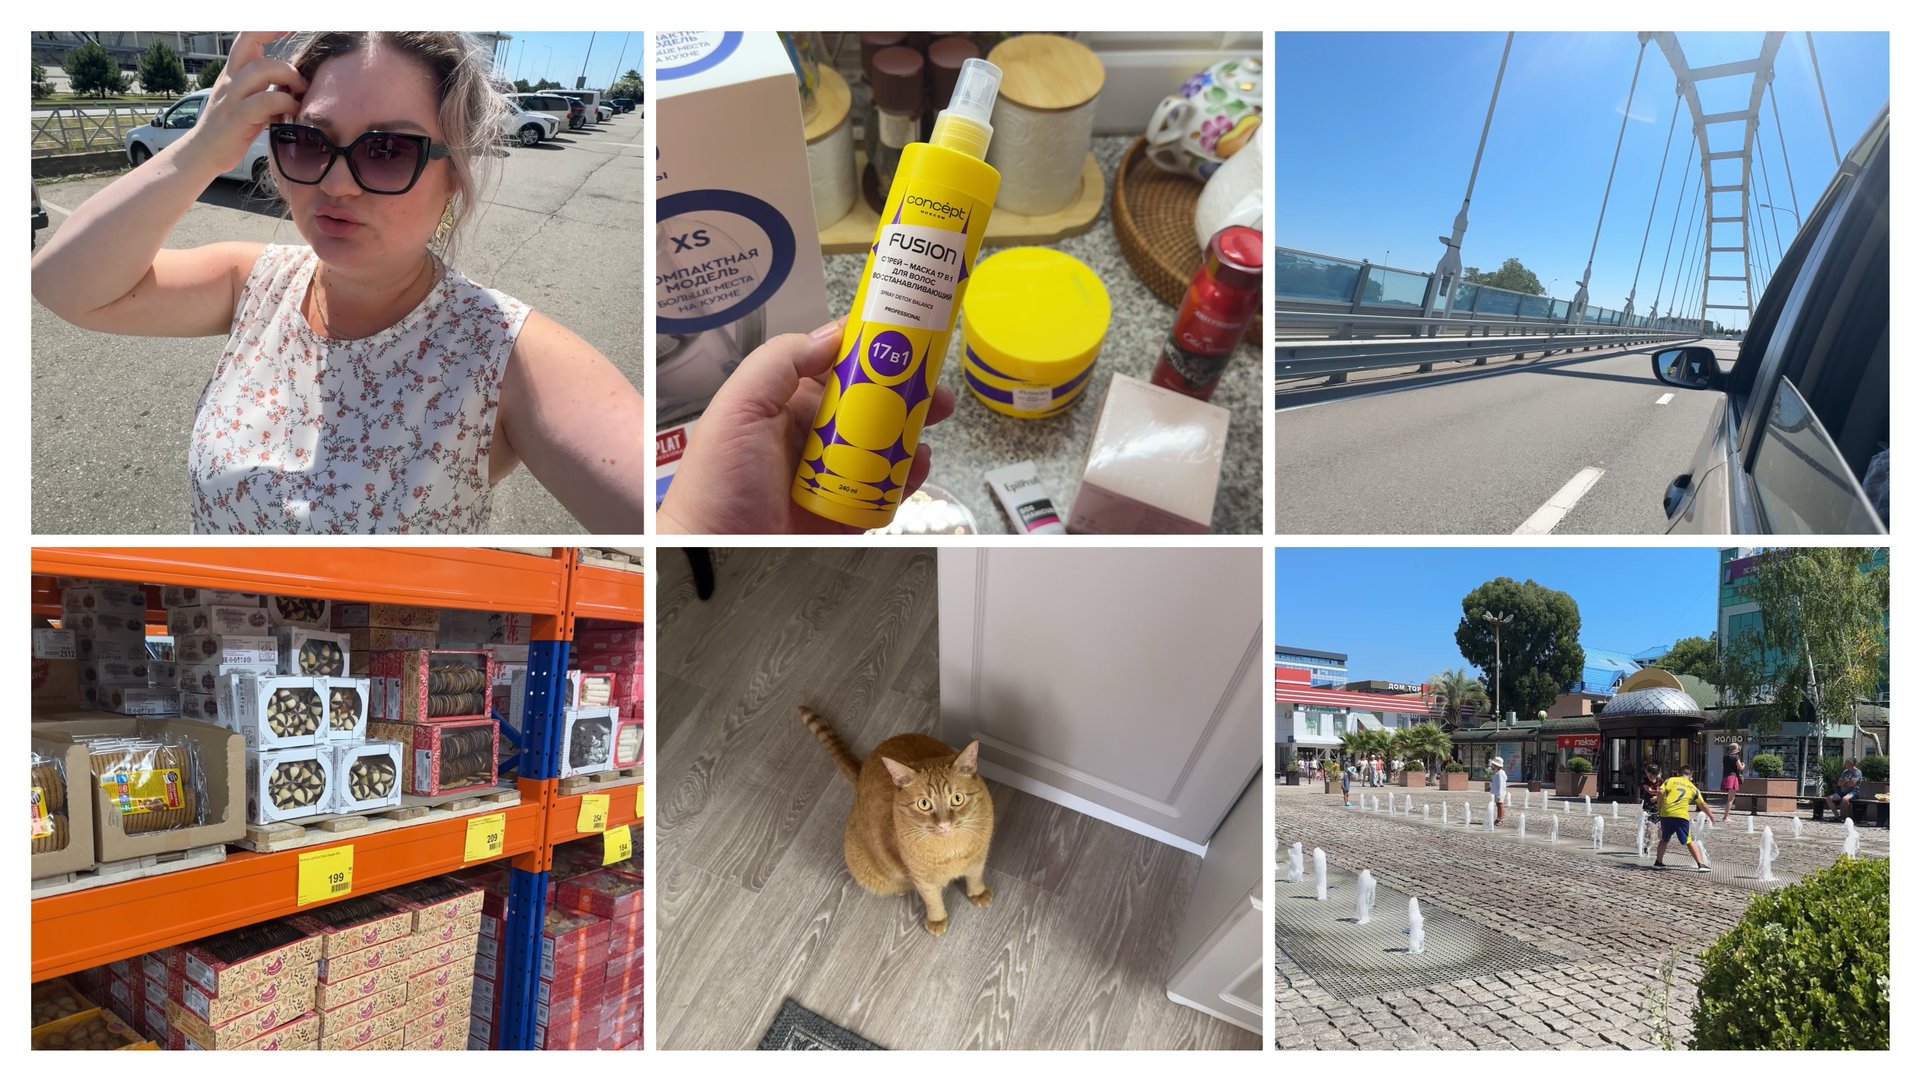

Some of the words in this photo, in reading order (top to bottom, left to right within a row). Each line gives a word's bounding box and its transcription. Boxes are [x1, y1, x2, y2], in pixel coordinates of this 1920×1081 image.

[892, 268, 909, 277] ДЛЯ
[909, 272, 936, 286] ВОЛОС
[909, 263, 936, 277] МАСКА
[666, 267, 739, 293] МОДЕЛЬ
[658, 287, 713, 309] БОЛЬШЕ
[714, 275, 754, 292] МЕСТА
[880, 289, 895, 298] SPRAY
[894, 293, 912, 304] DETOX
[679, 303, 697, 313] НА
[701, 289, 740, 306] КУХНЕ
[884, 306, 921, 321] PROFESSIONAL
[839, 484, 850, 492] 240
[1675, 788, 1686, 803] 7
[487, 833, 498, 844] 209
[328, 872, 344, 885] 199
